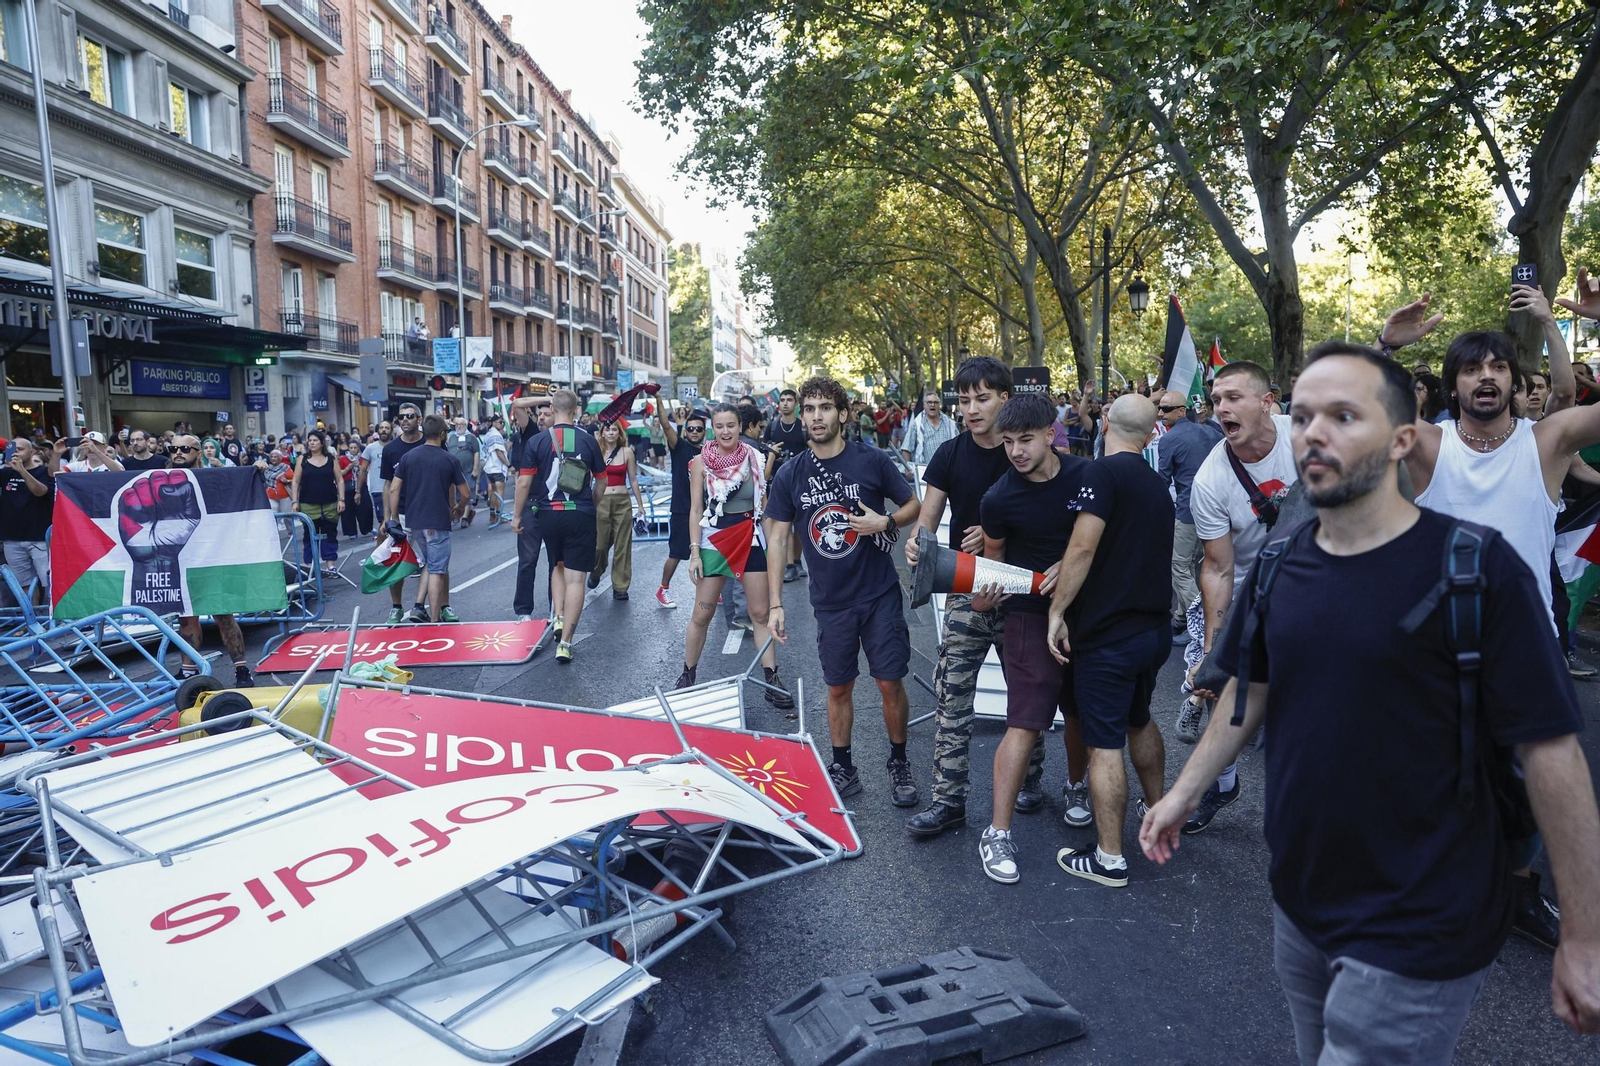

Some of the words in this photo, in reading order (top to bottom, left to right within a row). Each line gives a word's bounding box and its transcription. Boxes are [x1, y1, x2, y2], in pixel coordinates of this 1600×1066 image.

[143, 367, 184, 382] PARKING
[185, 368, 220, 384] PÚBLICO
[161, 383, 188, 393] ABIERTO
[685, 388, 697, 397] PAZ
[1014, 384, 1048, 392] TISSOT
[217, 412, 228, 421] PAZ
[145, 572, 171, 588] FREE
[135, 588, 181, 604] PALESTINE
[149, 783, 619, 945] Cofidis
